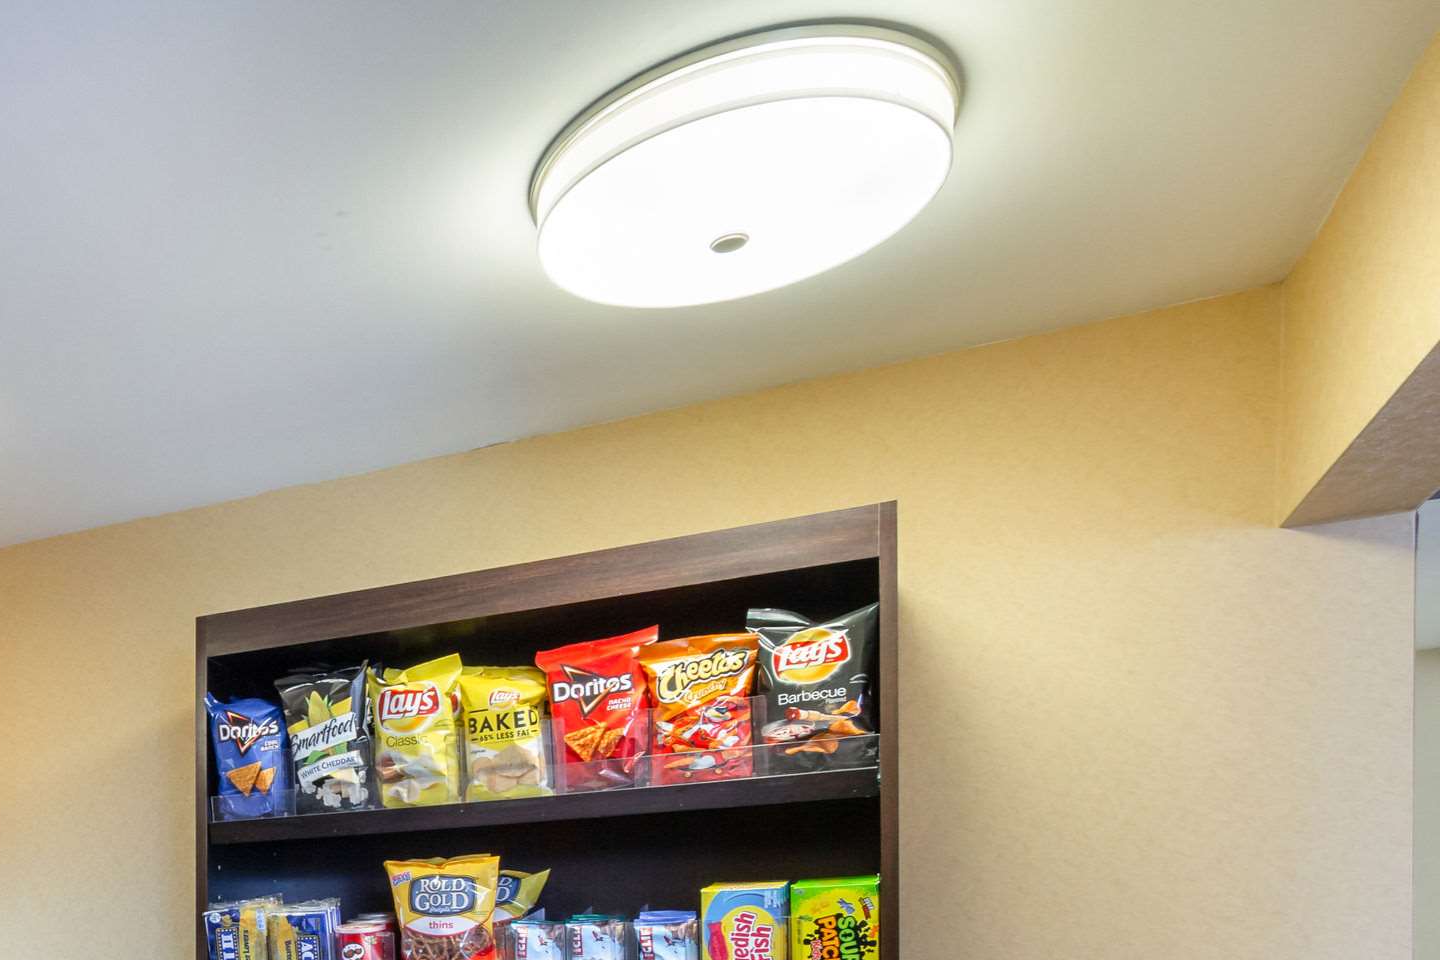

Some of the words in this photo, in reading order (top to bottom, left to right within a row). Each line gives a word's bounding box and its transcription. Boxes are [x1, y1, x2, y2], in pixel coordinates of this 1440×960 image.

[659, 649, 748, 702] Cheetos
[553, 673, 633, 702] Doritos
[777, 687, 847, 706] Barbecue
[218, 719, 280, 742] Doritos
[468, 707, 538, 734] BAKED
[290, 717, 357, 753] Smartfood
[496, 732, 515, 740] LESS
[420, 877, 467, 894] ROLD
[415, 891, 470, 912] GOLD
[428, 921, 454, 930] thins
